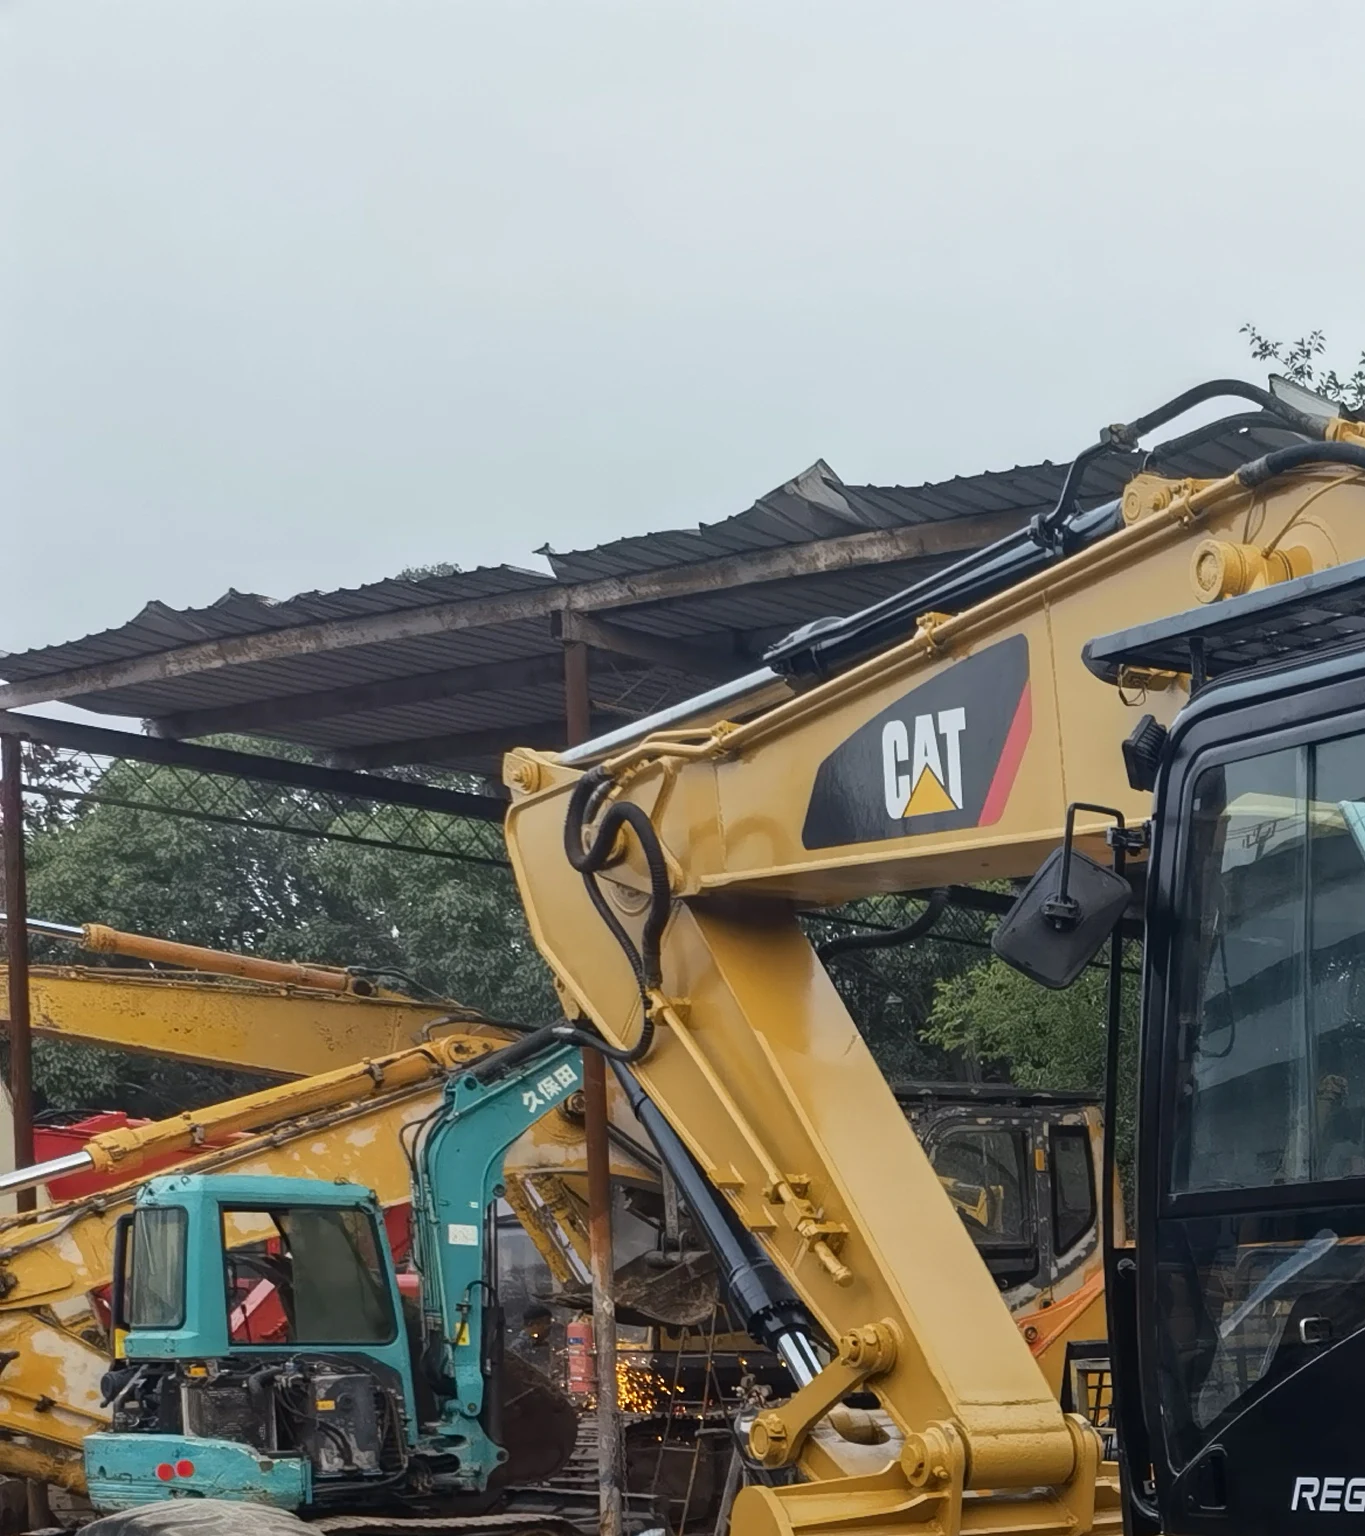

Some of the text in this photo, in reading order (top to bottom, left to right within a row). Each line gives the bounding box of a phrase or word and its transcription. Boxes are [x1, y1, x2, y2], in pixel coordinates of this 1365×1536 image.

[882, 706, 966, 820] CAT
[522, 1063, 578, 1113] 久保田
